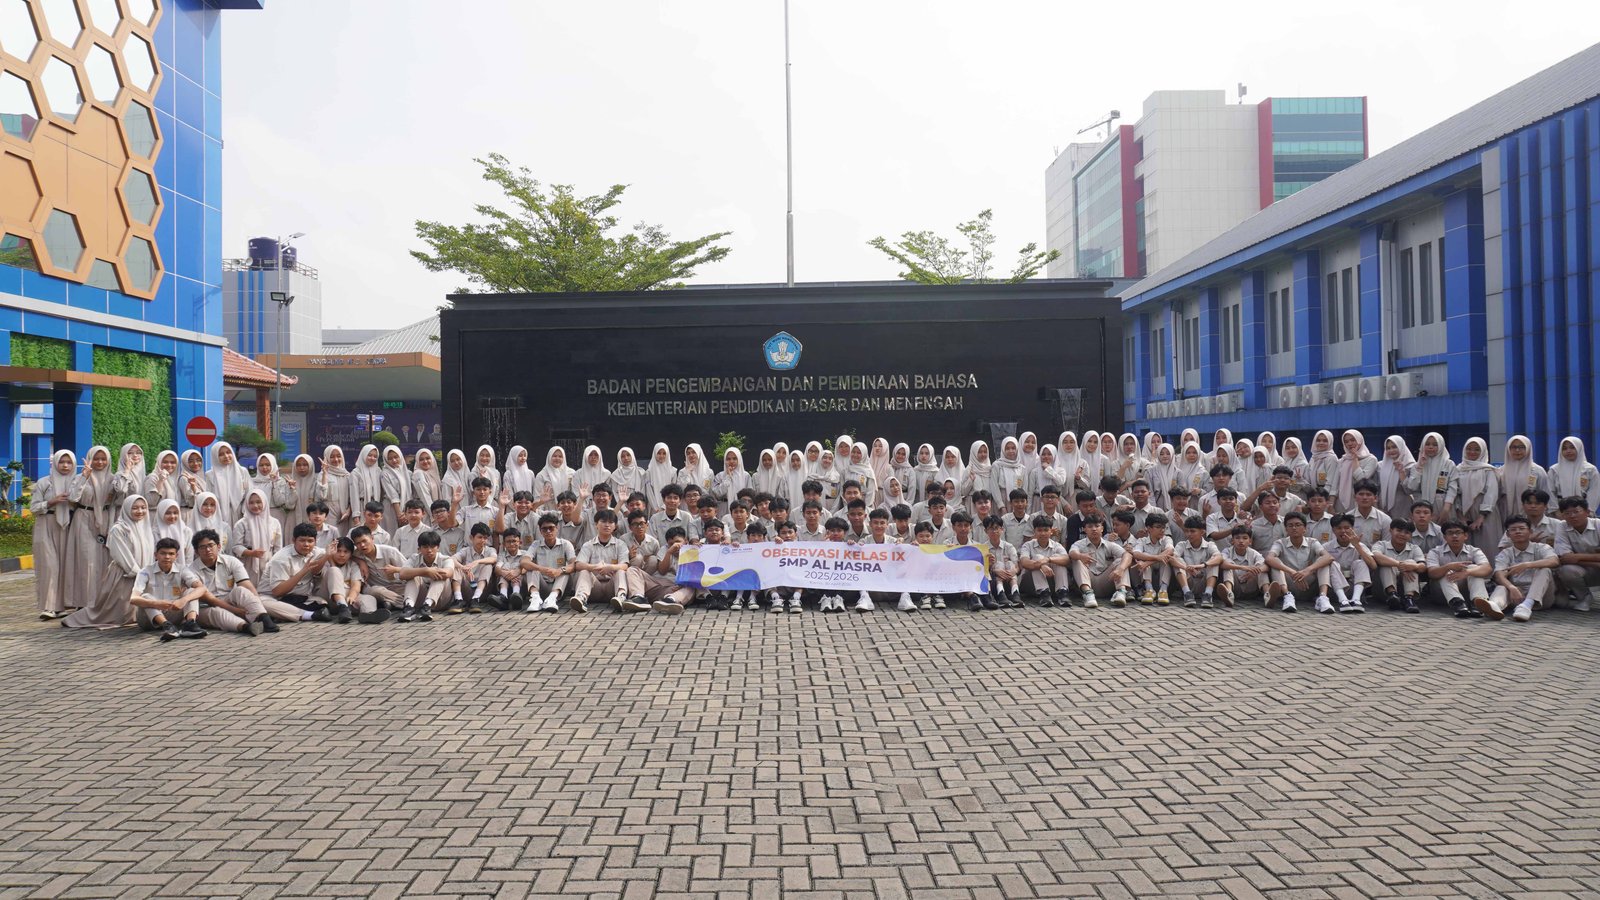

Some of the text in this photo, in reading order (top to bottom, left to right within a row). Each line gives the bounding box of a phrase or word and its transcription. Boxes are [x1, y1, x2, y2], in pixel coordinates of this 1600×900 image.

[587, 373, 978, 395] BADAN PENGEMBANGAN DAN PEMBINAAN BAHASA
[607, 395, 963, 416] KEMENTERIAN PENDIDIKAN DASAR DAN MENENGAH
[762, 548, 905, 561] OBSERVASI KELAS IX
[779, 558, 883, 573] SMP AL HASRA
[804, 570, 860, 582] 2025/2026
